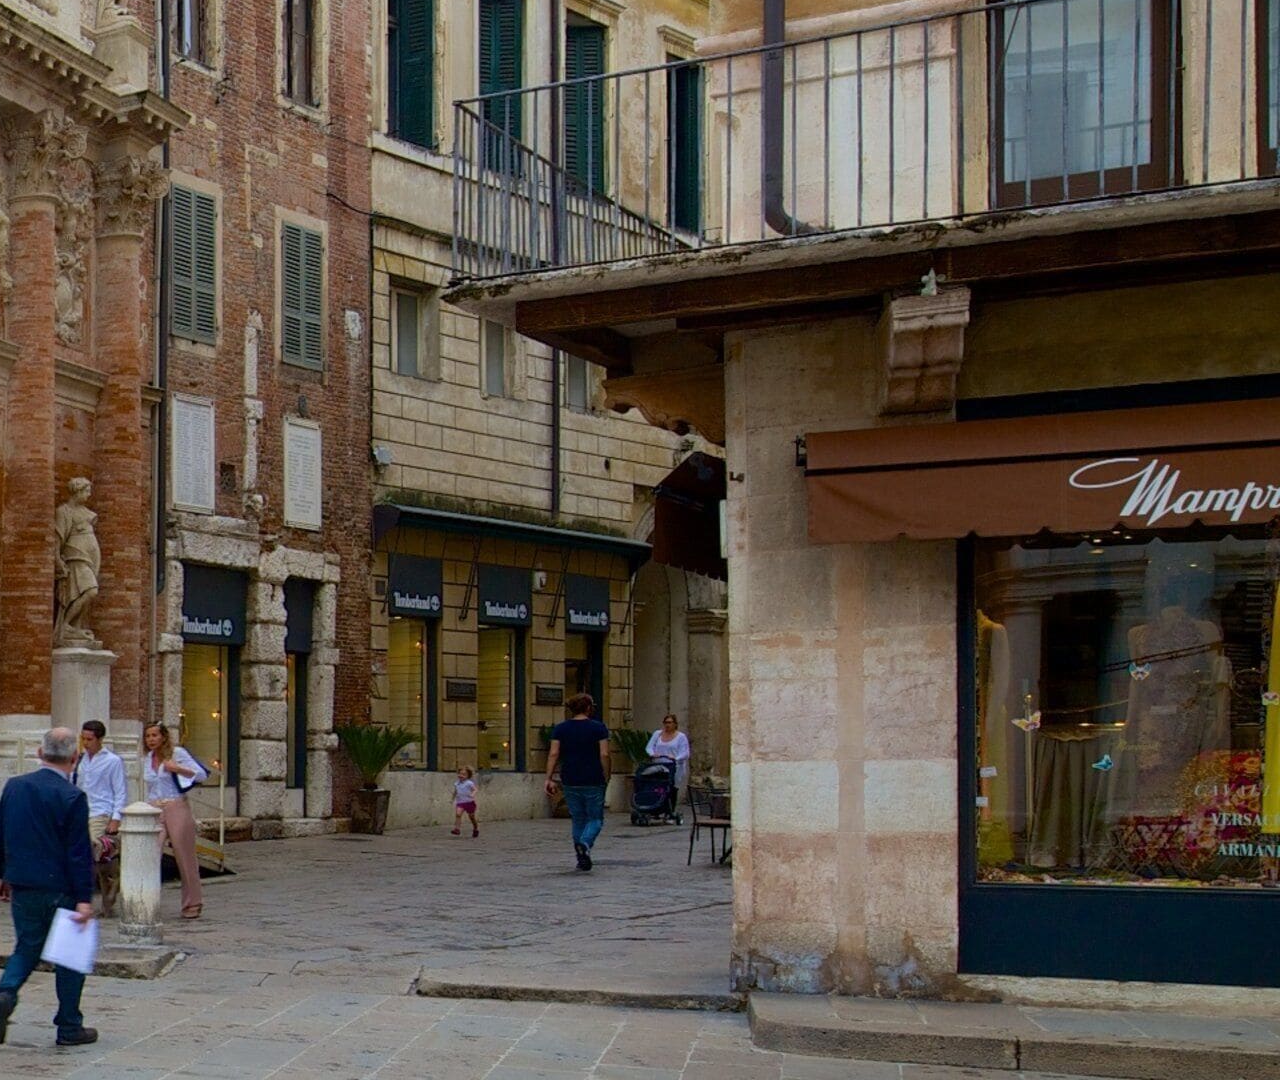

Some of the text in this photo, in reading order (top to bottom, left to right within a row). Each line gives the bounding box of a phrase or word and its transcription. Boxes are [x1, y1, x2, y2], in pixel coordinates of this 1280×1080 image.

[393, 591, 431, 610] Timberland
[485, 601, 519, 618] Timberland
[569, 609, 600, 625] Timberland
